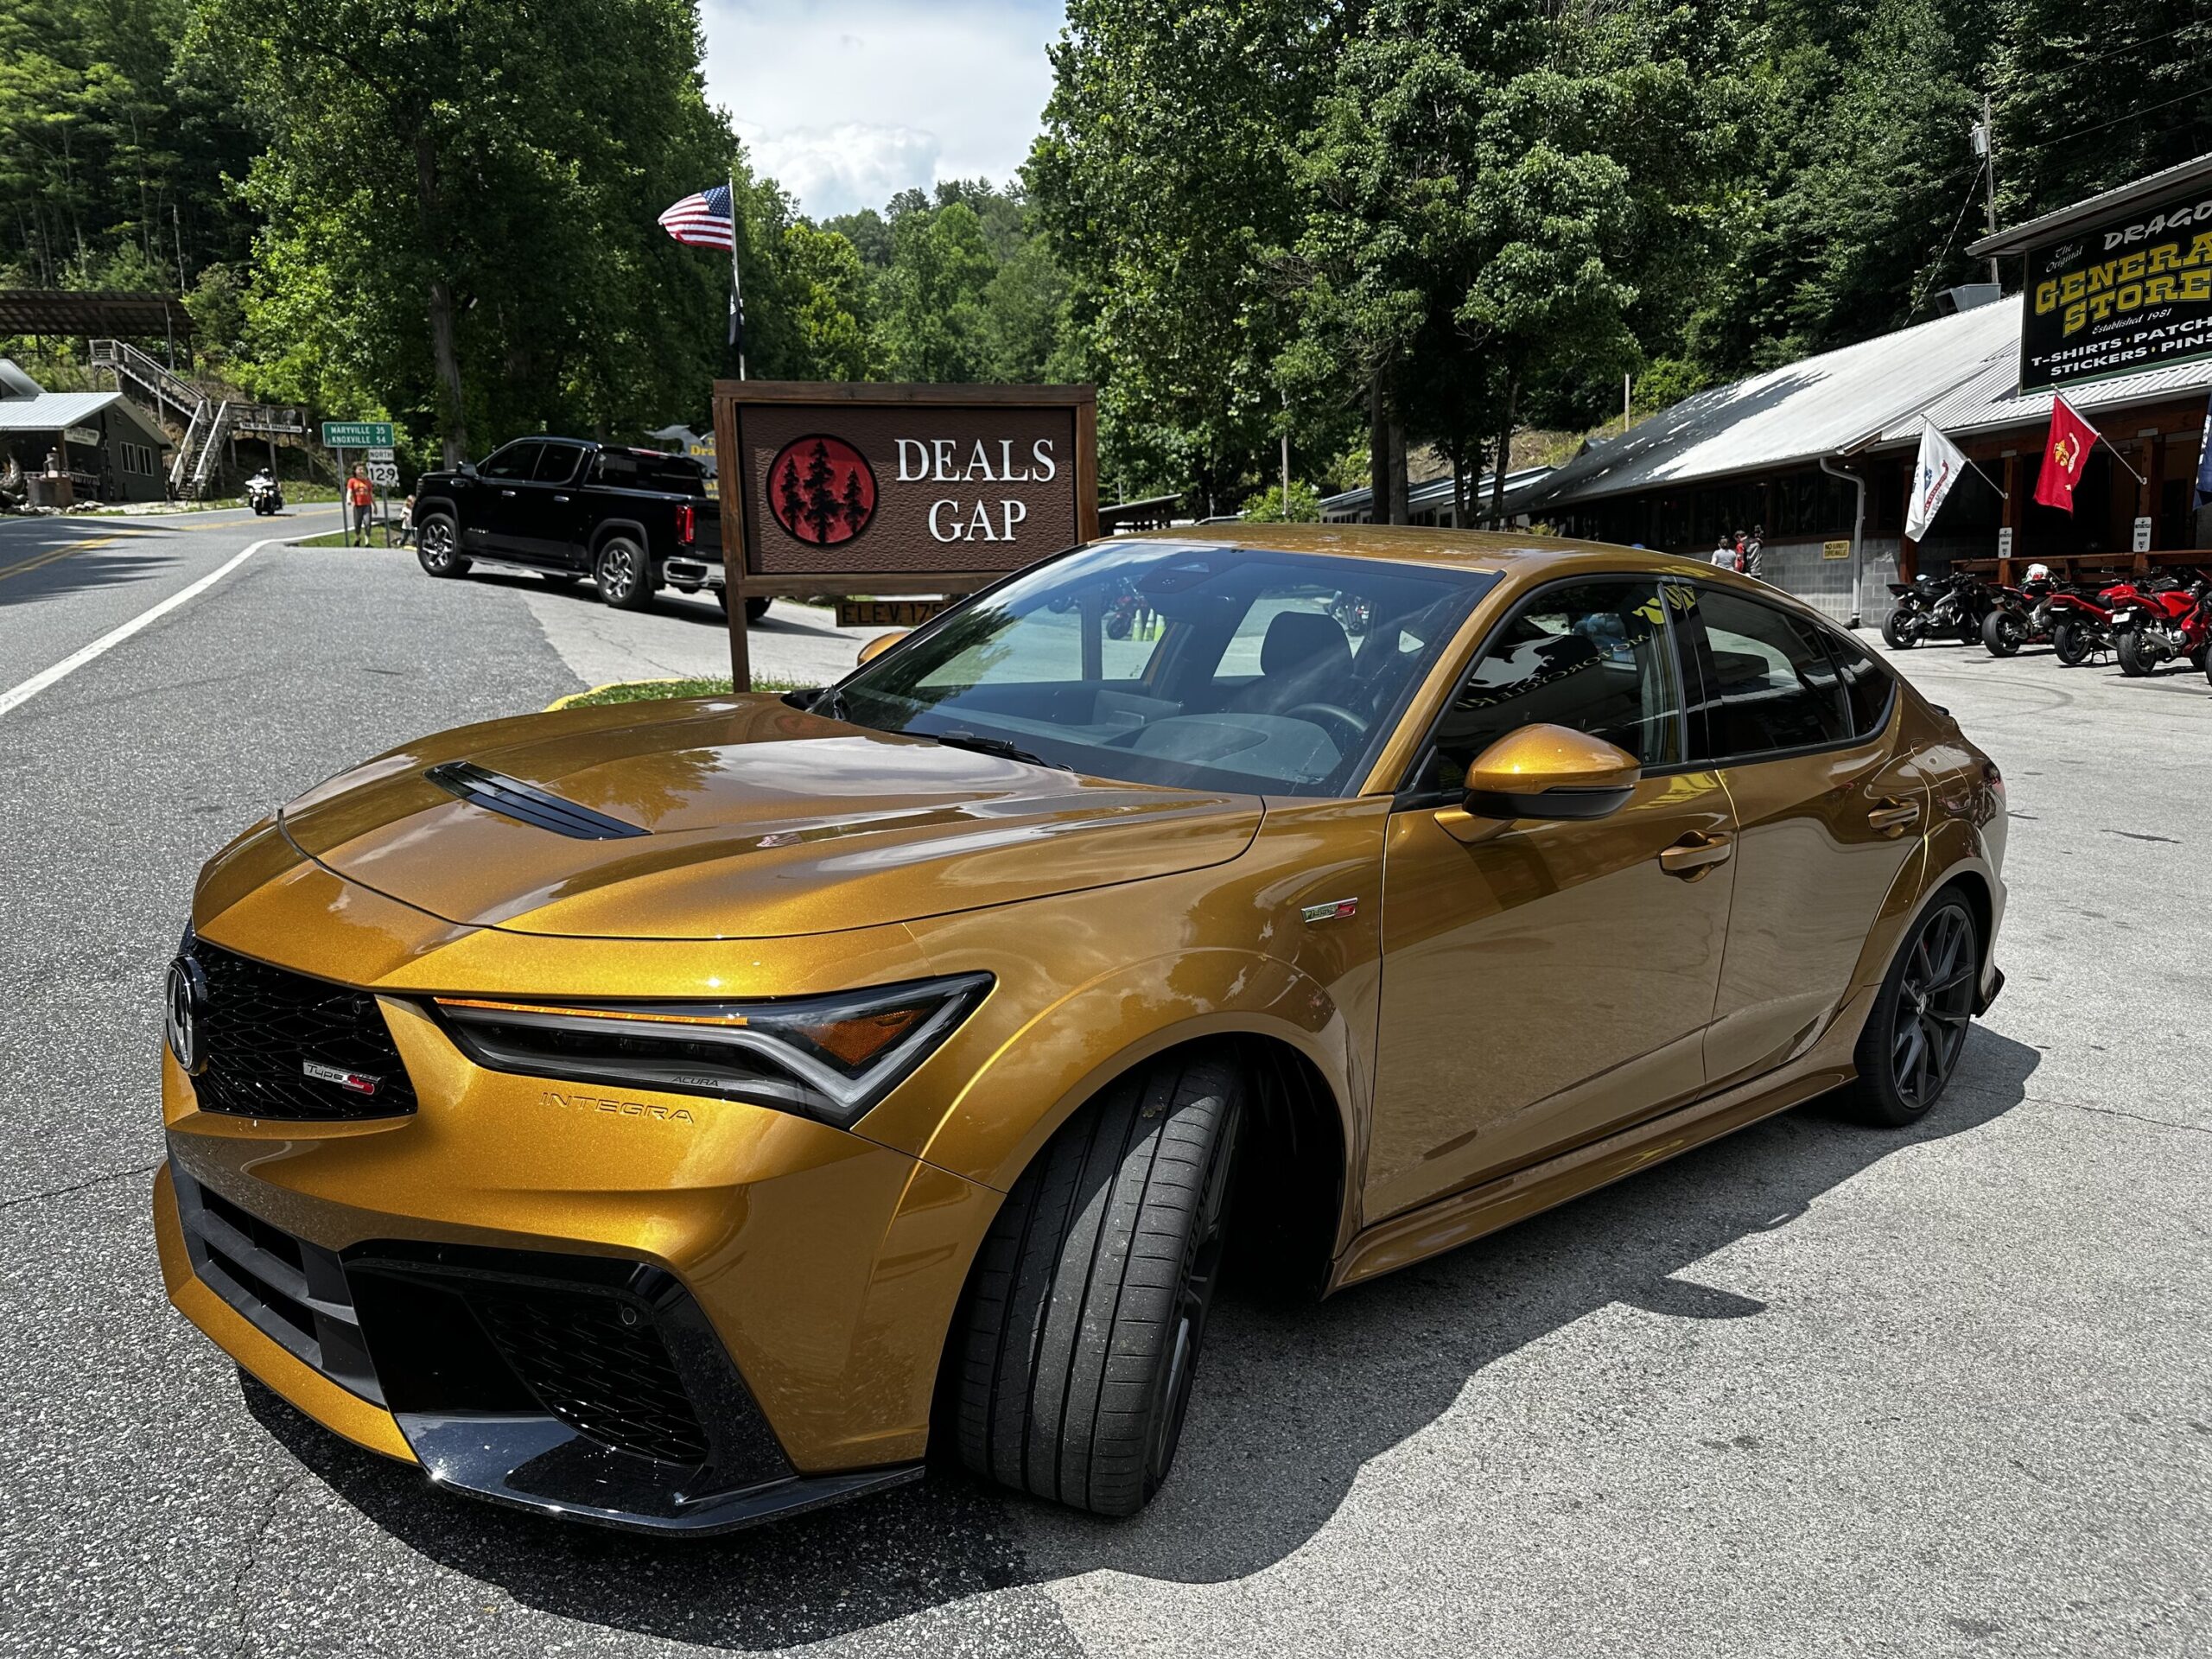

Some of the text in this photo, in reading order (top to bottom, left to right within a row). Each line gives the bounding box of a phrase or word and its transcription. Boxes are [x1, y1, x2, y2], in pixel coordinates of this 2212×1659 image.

[2045, 245, 2083, 273] Original
[2055, 244, 2073, 258] The
[2063, 268, 2212, 338] STORE
[2092, 308, 2171, 335] Established 1981
[2031, 338, 2122, 366] T-SHIRTS
[2050, 346, 2148, 376] STICKERS
[331, 426, 385, 435] MARYVILLE 35
[332, 435, 386, 444] KNOXVILLE 54
[370, 467, 396, 481] 129
[893, 438, 1056, 483] DEALS
[928, 499, 1027, 543] GAP
[842, 604, 902, 623] ELEV.
[307, 1064, 376, 1096] Type S
[671, 1076, 719, 1086] ACURA
[538, 1091, 695, 1124] INTEGRA
